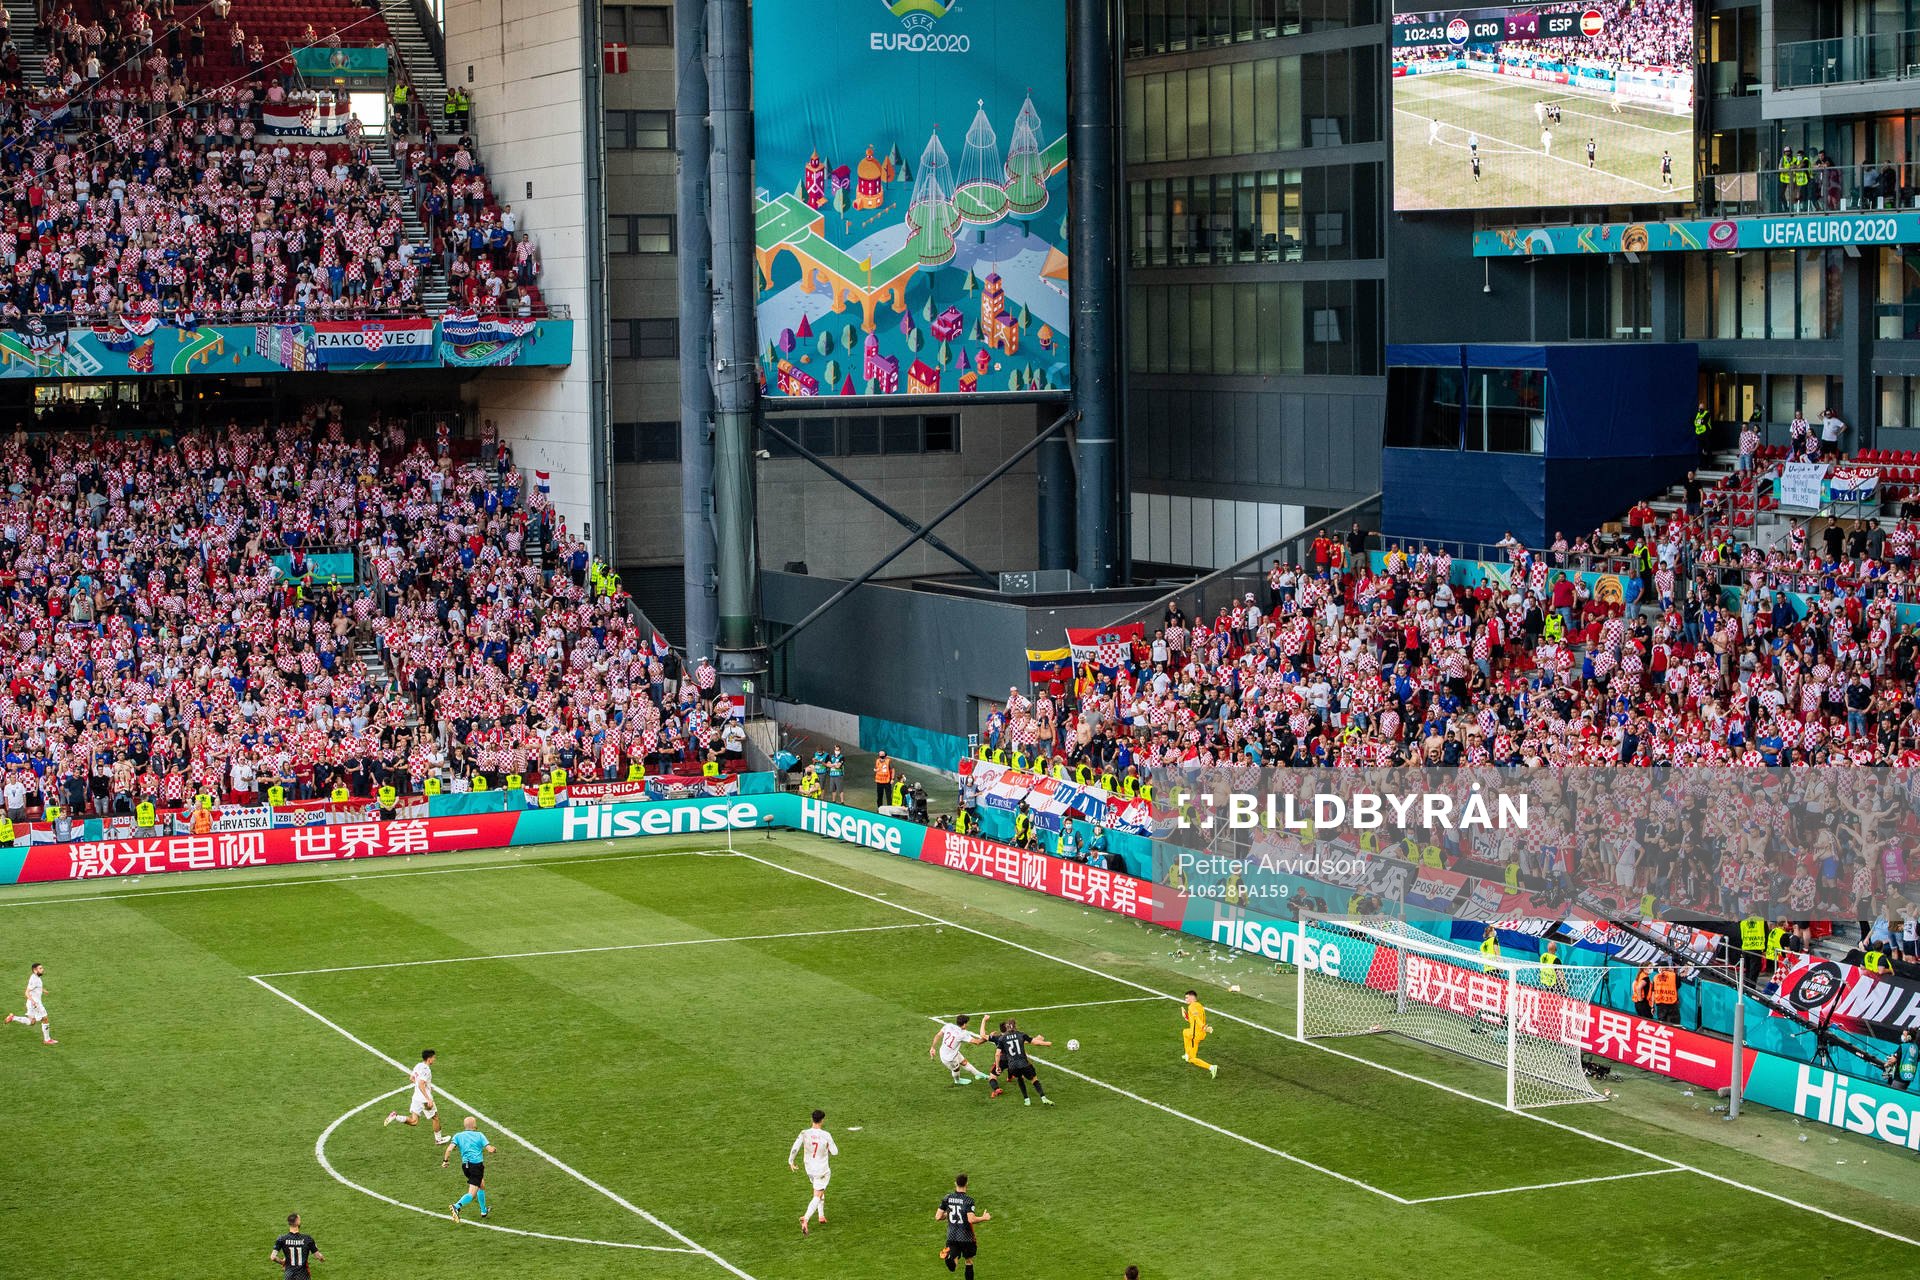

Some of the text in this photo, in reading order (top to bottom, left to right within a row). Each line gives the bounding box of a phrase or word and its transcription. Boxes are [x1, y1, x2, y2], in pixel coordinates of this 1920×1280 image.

[902, 16, 934, 29] UEFA
[1404, 27, 1445, 41] 102:43
[1474, 23, 1498, 37] CRO
[1549, 19, 1573, 32] ESP
[1763, 218, 1897, 244] UEFA EURO 2020
[572, 782, 641, 796] KAMEŠNICA
[219, 816, 268, 830] HRVATSKA
[562, 801, 758, 841] Hisense
[800, 796, 902, 855] Hisense
[1034, 812, 1051, 829] ÖLN
[69, 821, 478, 878] 激光电视 世界第一
[944, 833, 1164, 915] 激光电视 世界第一
[1211, 900, 1341, 977] Hisense
[1835, 974, 1905, 1023] MI
[943, 1031, 956, 1049] 21
[1006, 1039, 1021, 1056] 21
[1559, 1001, 1716, 1073] 世界第一
[811, 1142, 819, 1158] 7
[948, 1204, 964, 1224] 25
[288, 1246, 303, 1266] 11
